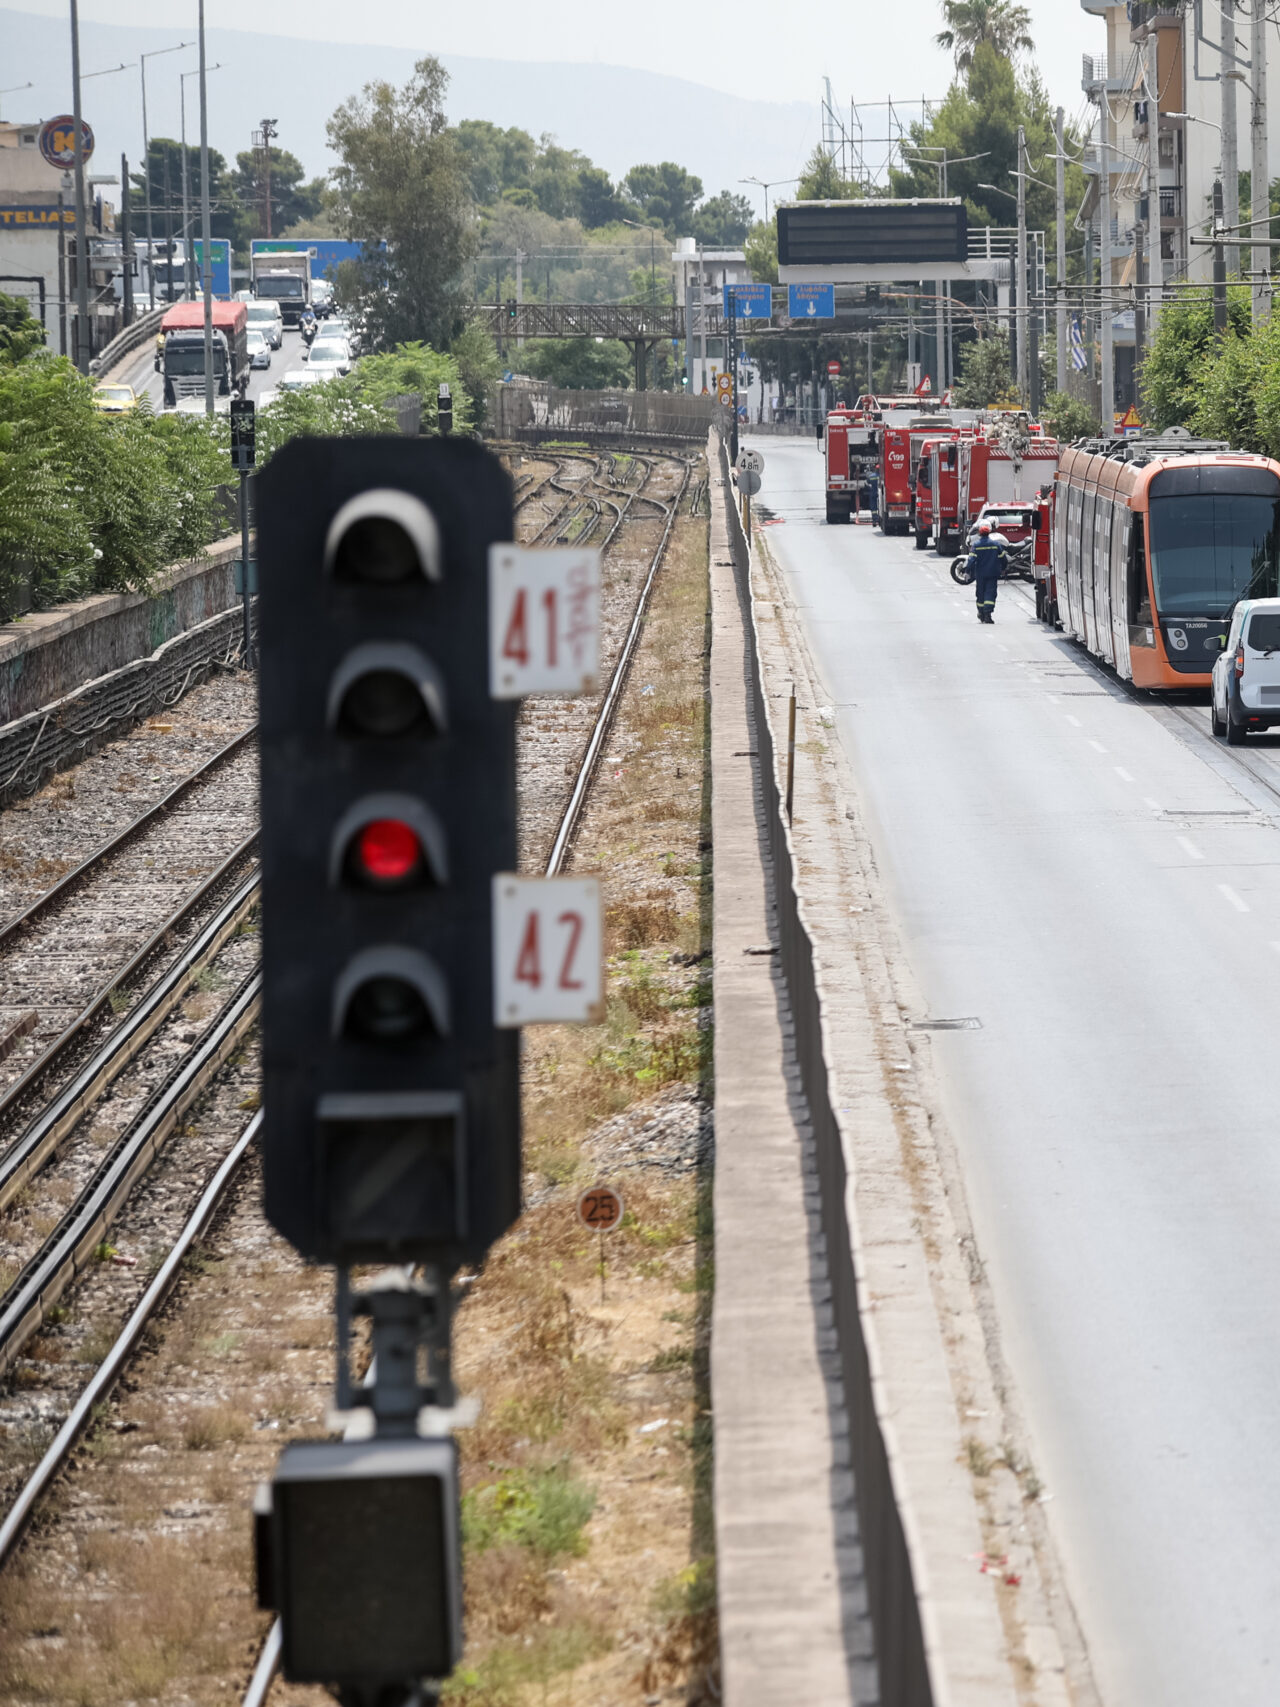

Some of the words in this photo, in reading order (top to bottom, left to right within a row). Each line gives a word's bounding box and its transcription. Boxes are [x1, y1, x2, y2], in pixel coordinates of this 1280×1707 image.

[502, 585, 558, 668] 41
[513, 908, 586, 991] 42
[585, 1195, 615, 1222] 25
